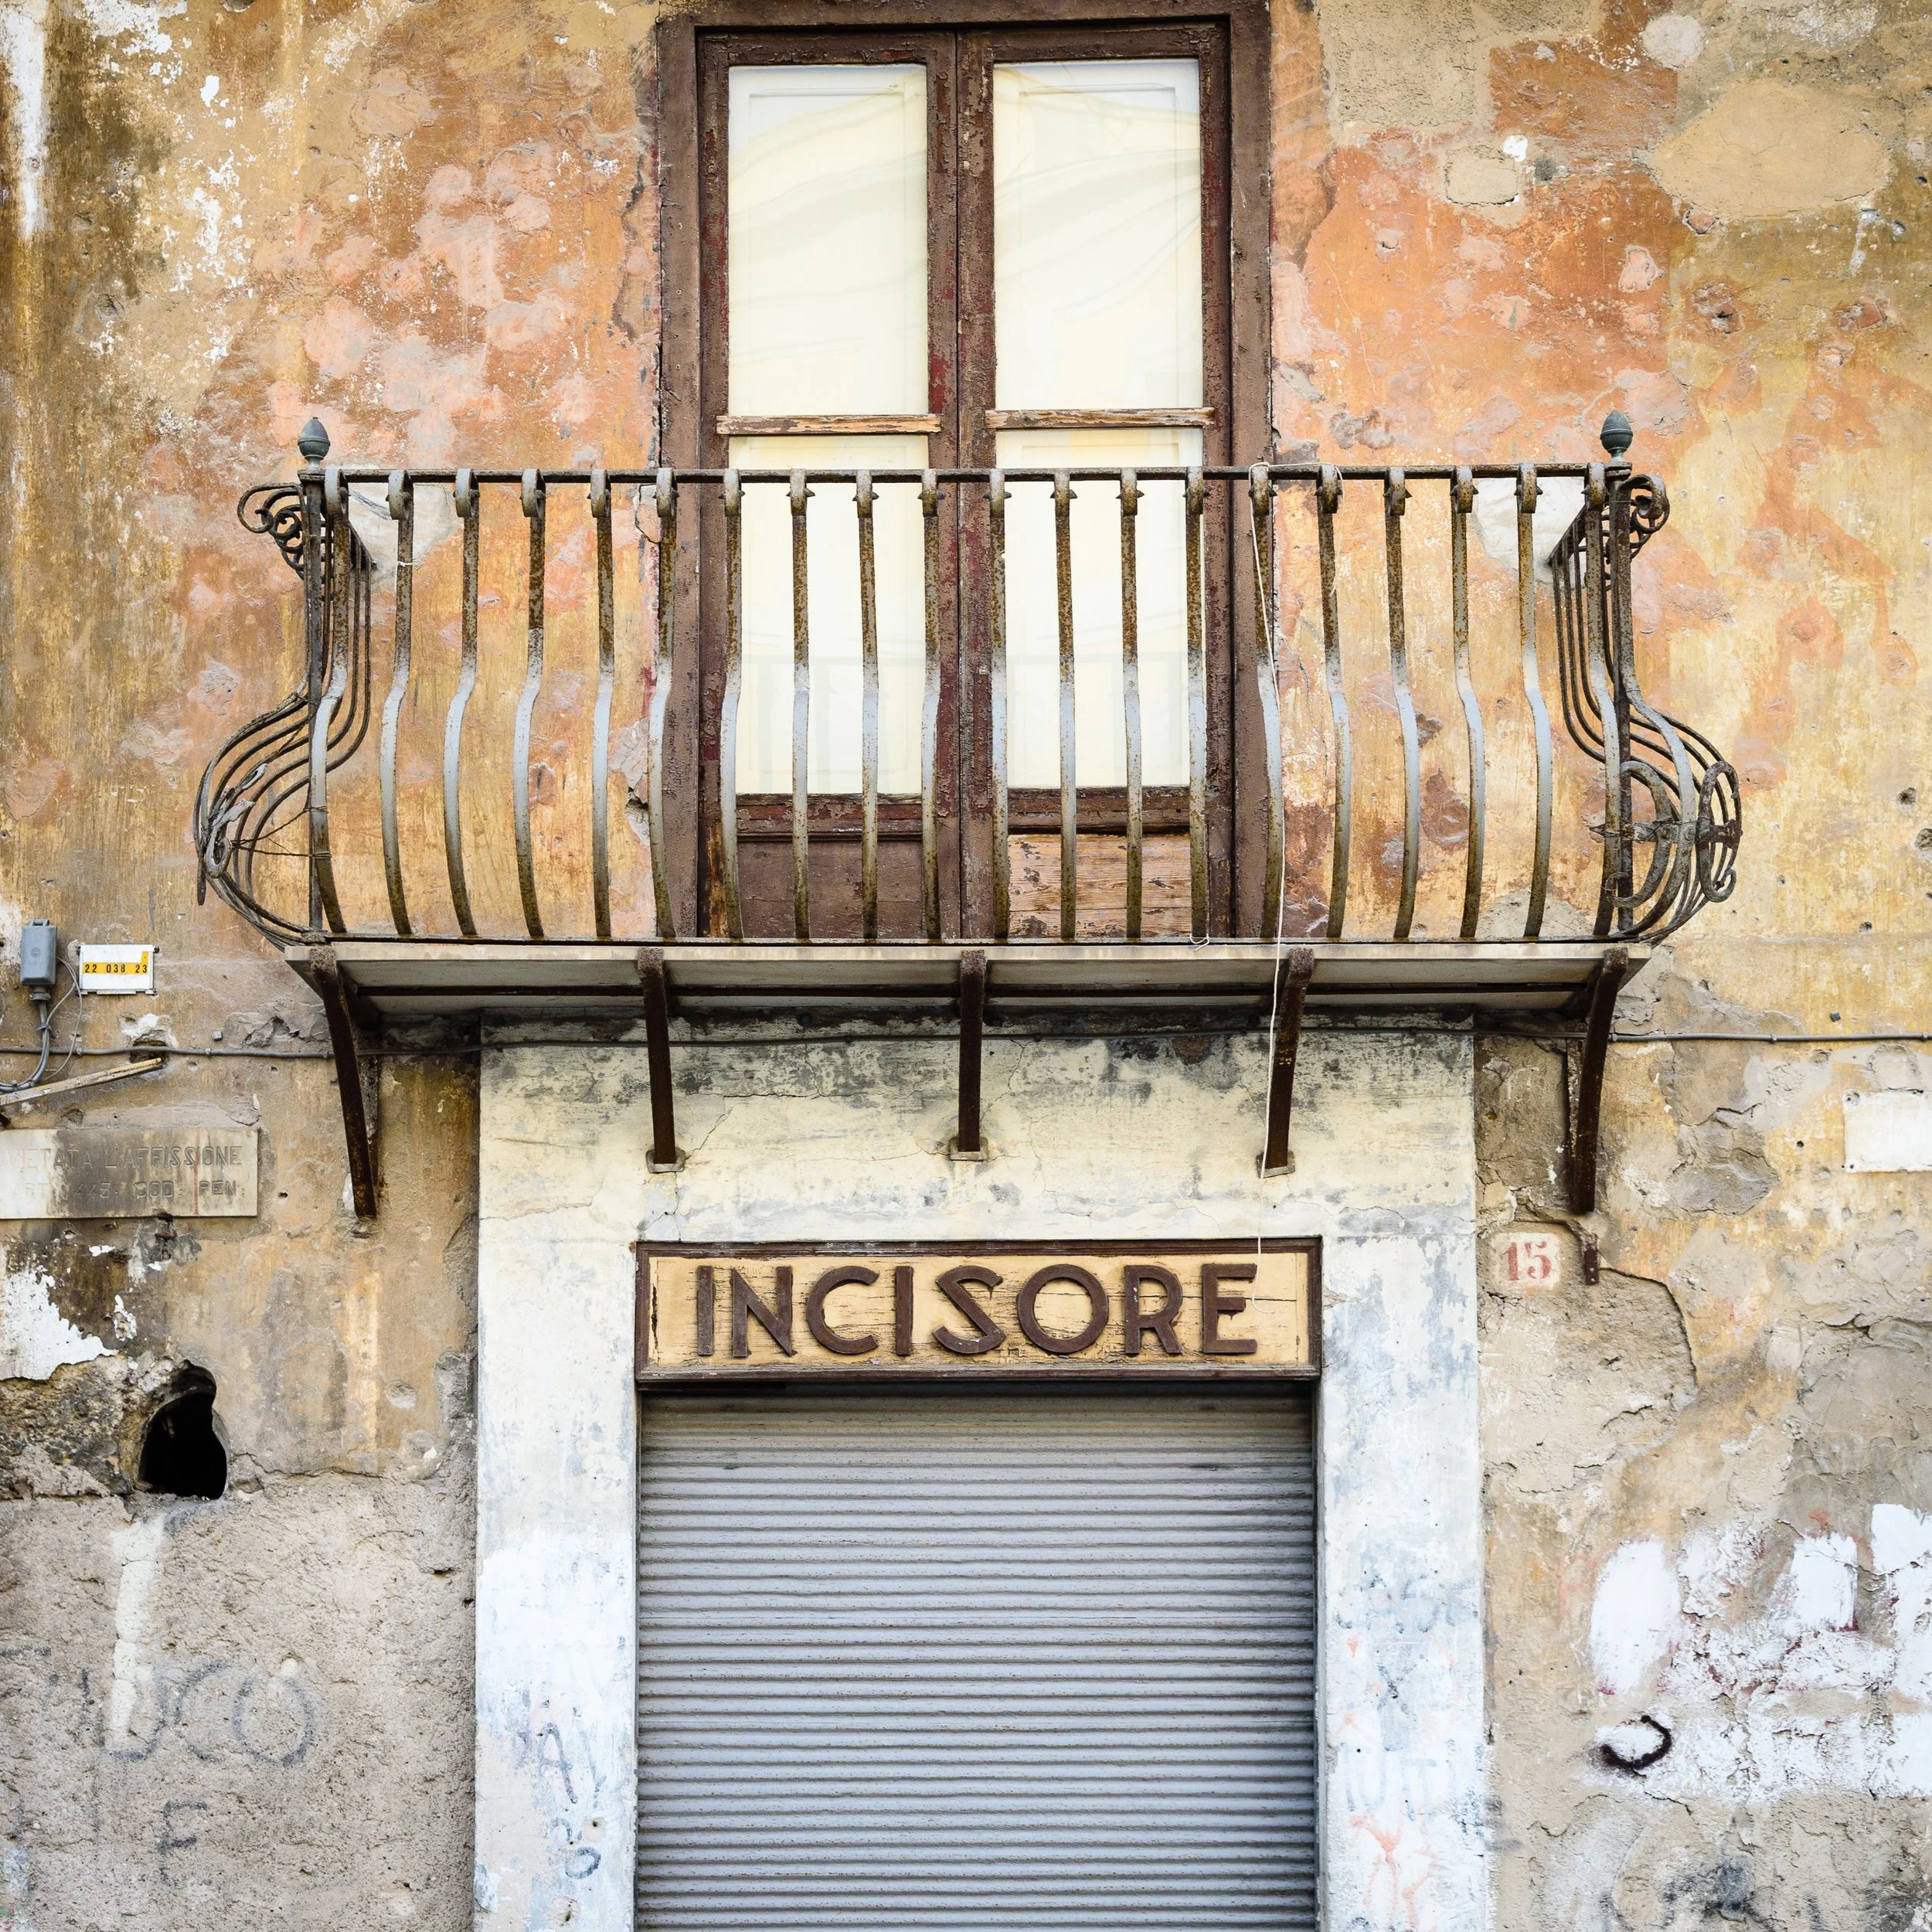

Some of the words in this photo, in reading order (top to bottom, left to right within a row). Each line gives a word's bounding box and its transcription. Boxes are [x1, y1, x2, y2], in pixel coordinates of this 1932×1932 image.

[84, 964, 97, 973] 22
[106, 964, 125, 973] 038
[135, 964, 148, 973] 23
[1502, 1240, 1552, 1281] 15
[697, 1263, 1257, 1357] INCISORE
